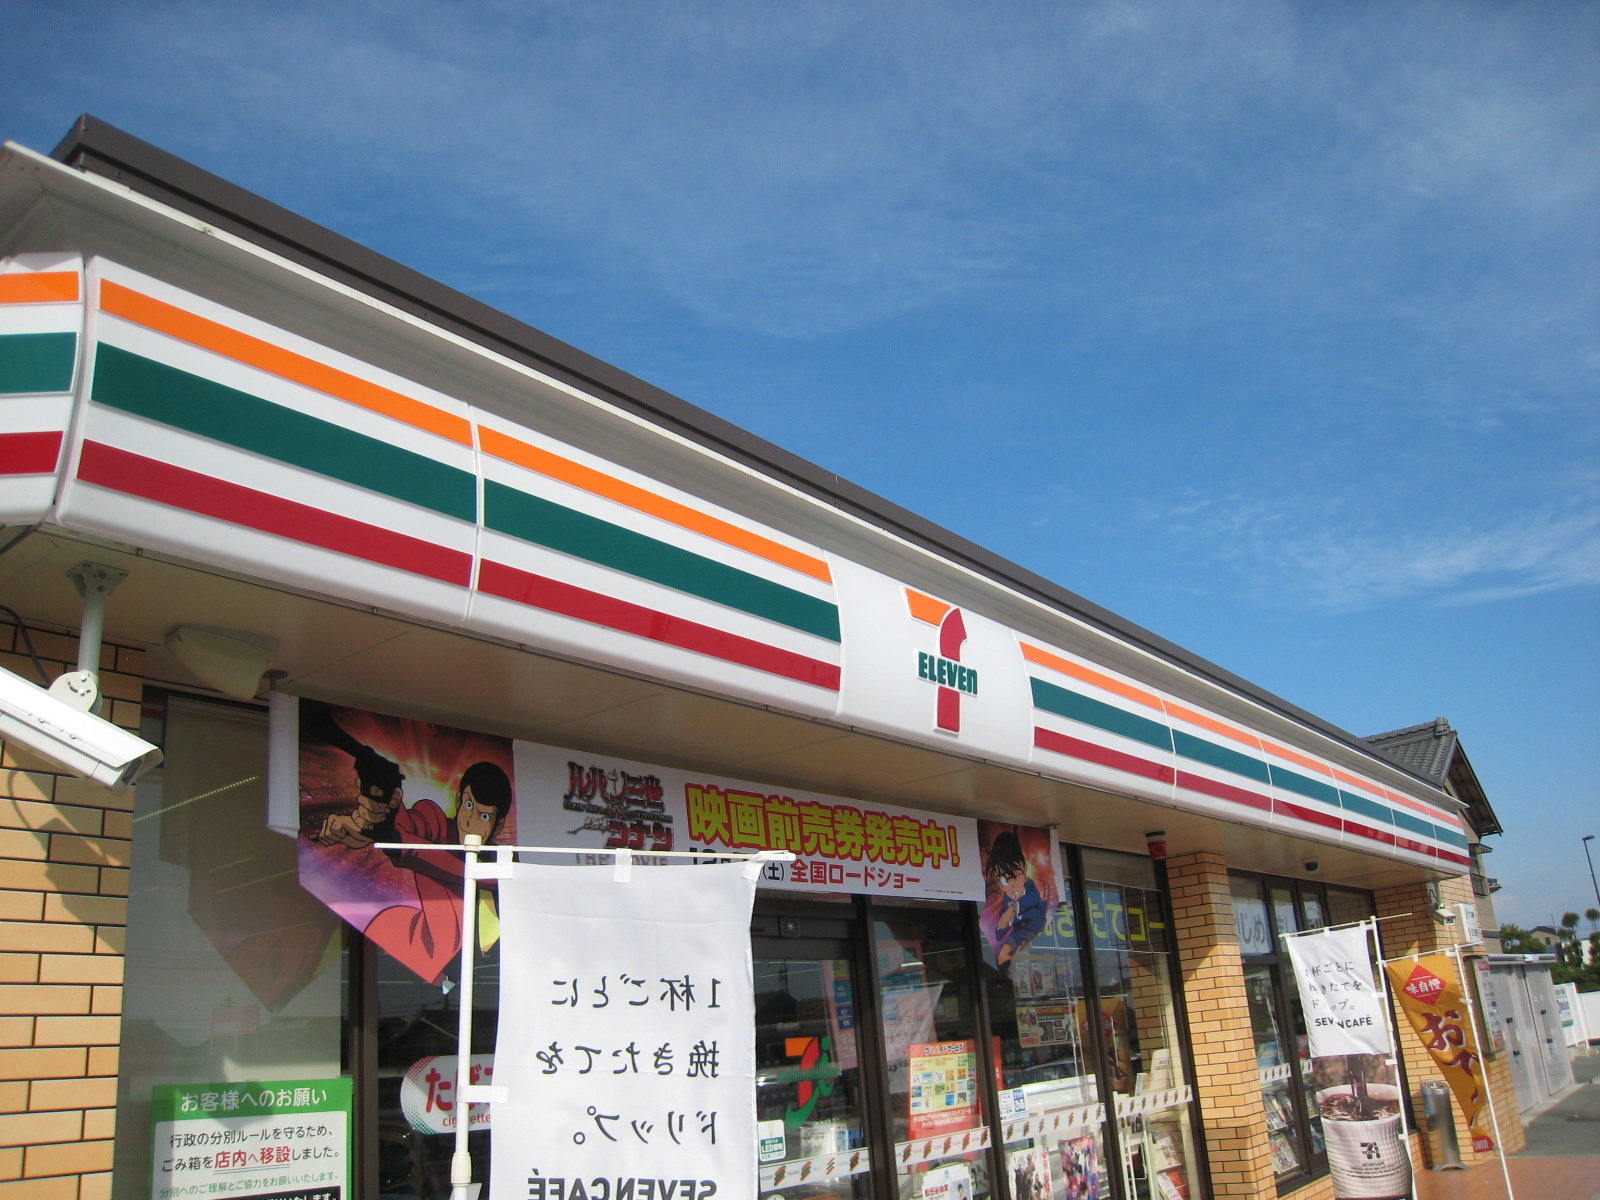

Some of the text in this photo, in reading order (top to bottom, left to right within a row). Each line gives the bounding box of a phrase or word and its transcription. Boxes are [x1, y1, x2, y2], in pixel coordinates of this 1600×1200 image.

[790, 859, 920, 889] 全国ロードショー
[181, 1087, 327, 1112] お客様へのお願い
[169, 1124, 334, 1149] 行政の分別ルールを守るため、
[161, 1145, 340, 1173] ごみ箱を店内へ移設しました。
[159, 1171, 340, 1199] 分別へのご理解とご協力をお願いいたします。
